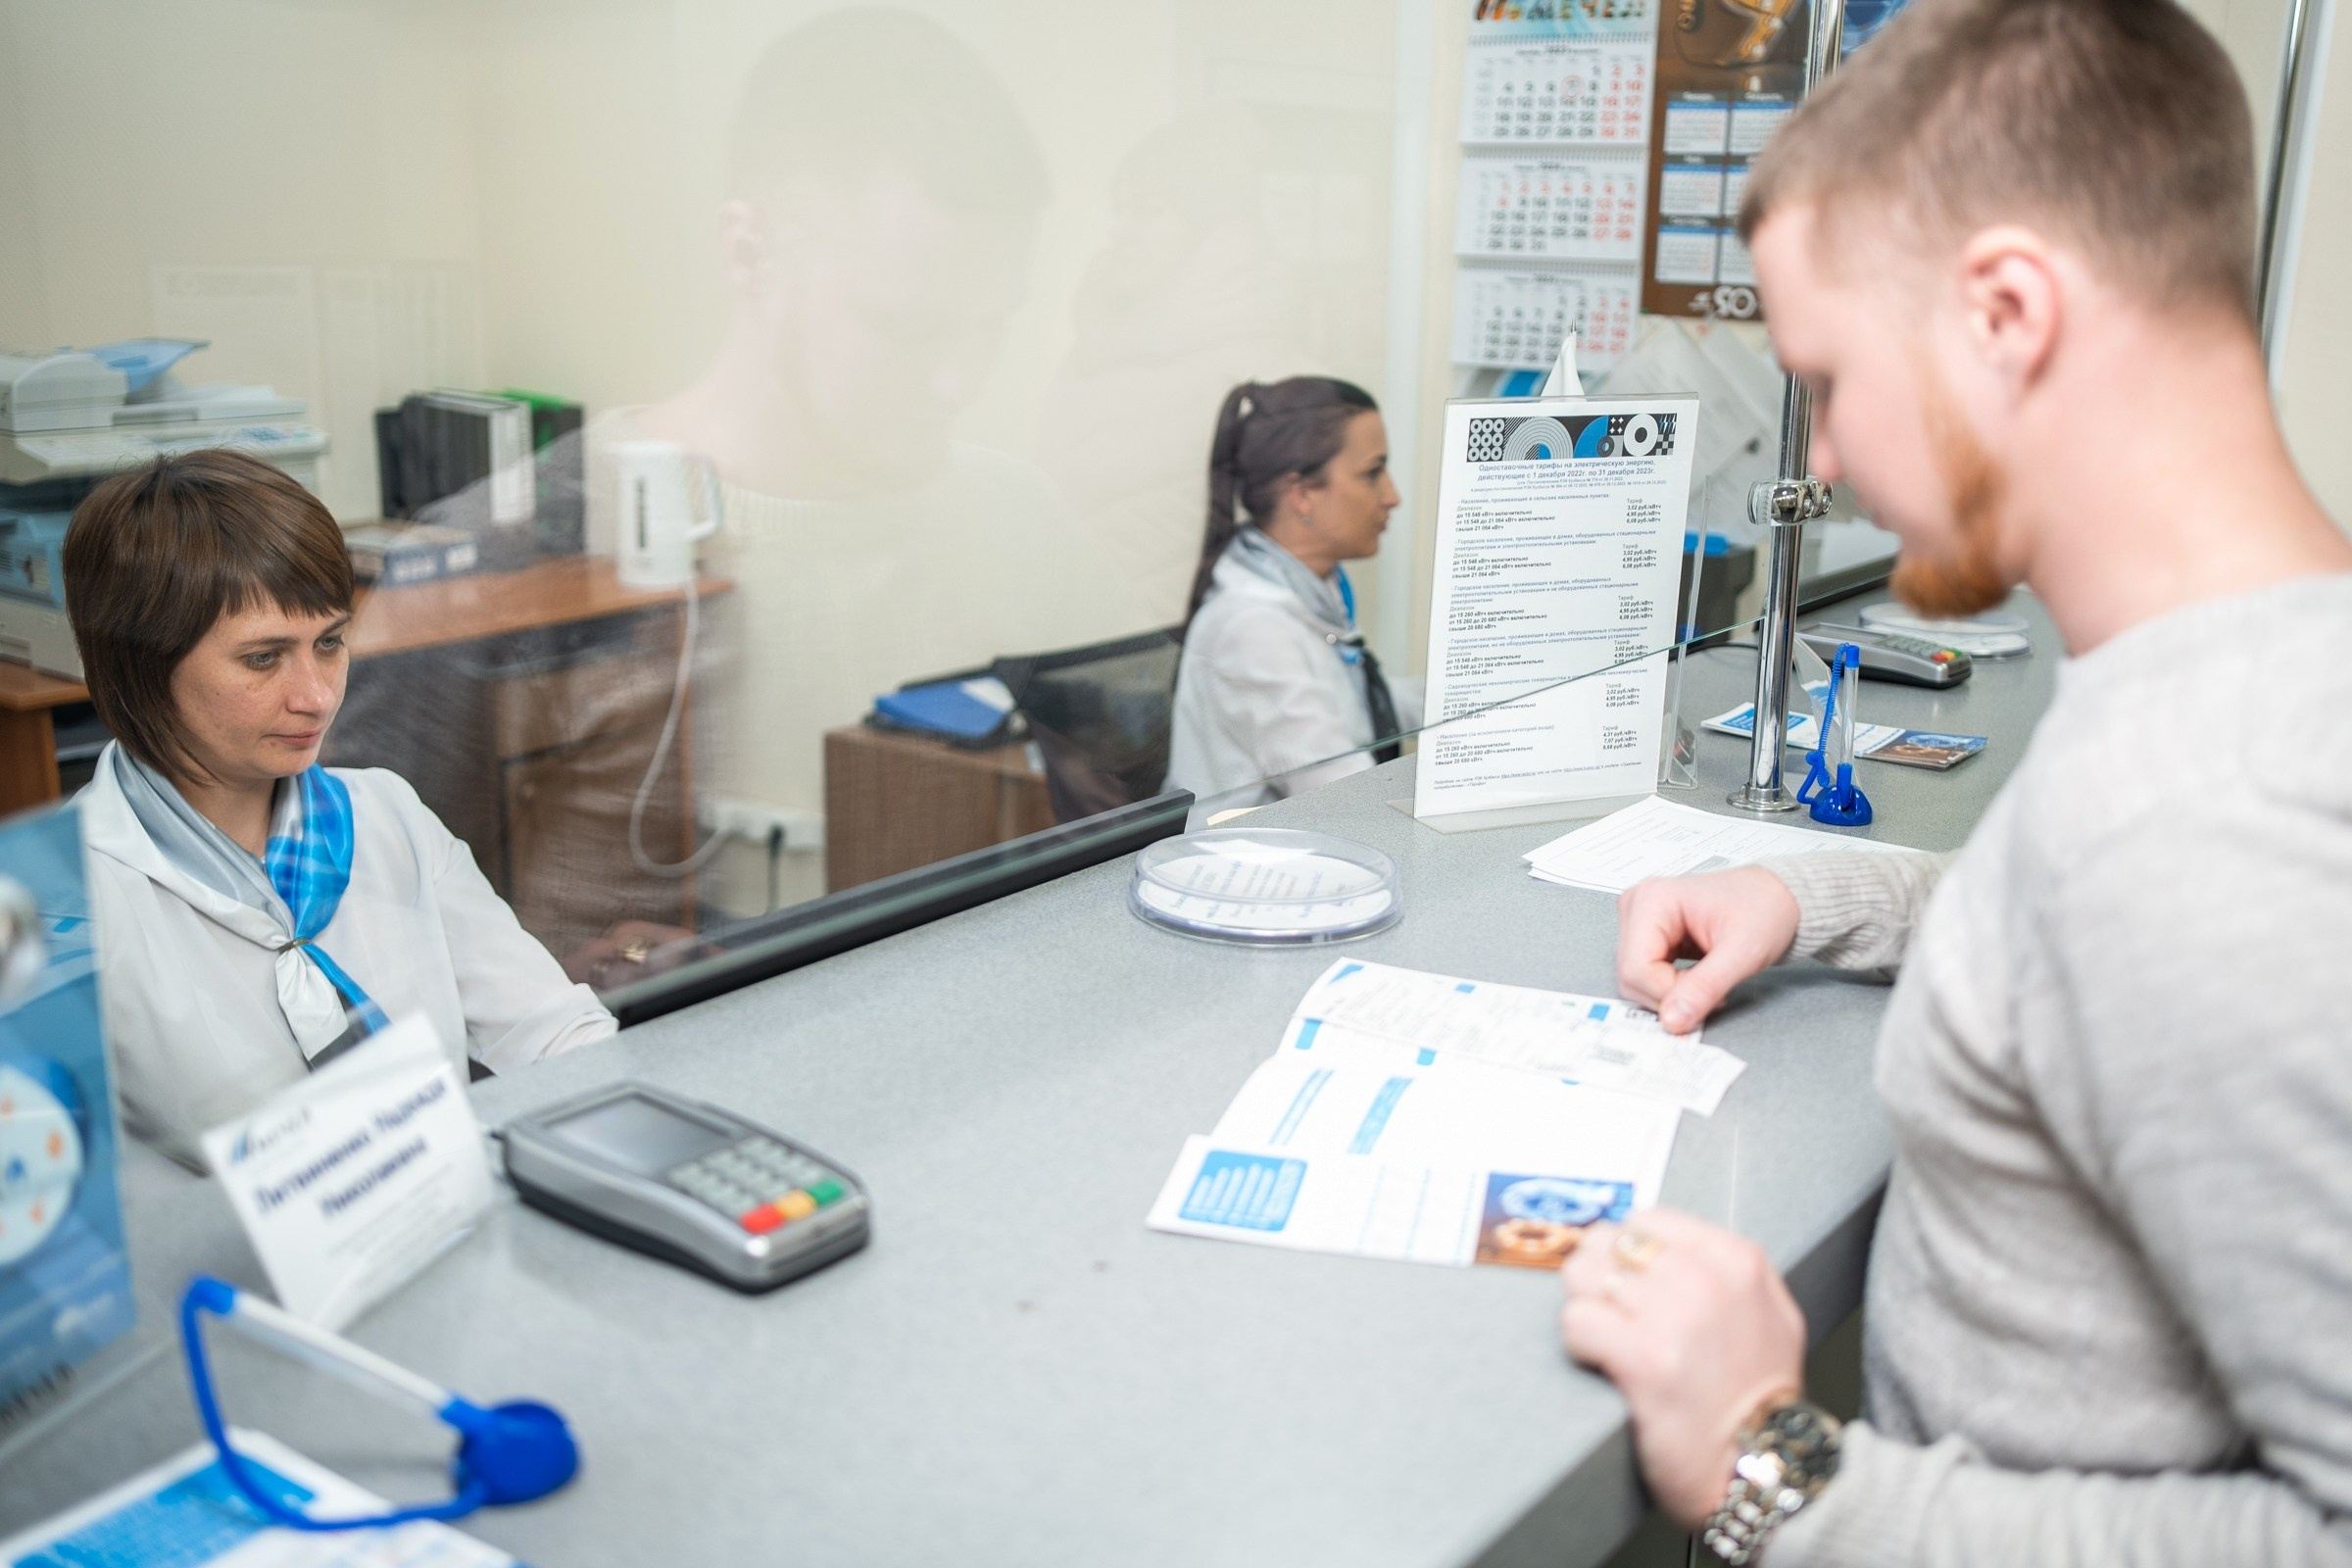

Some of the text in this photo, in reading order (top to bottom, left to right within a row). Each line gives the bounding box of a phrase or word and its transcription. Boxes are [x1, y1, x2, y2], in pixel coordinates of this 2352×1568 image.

[1478, 464, 1535, 472] Одноставочные
[1538, 470, 1566, 479] декабря
[1607, 467, 1636, 476] декабря
